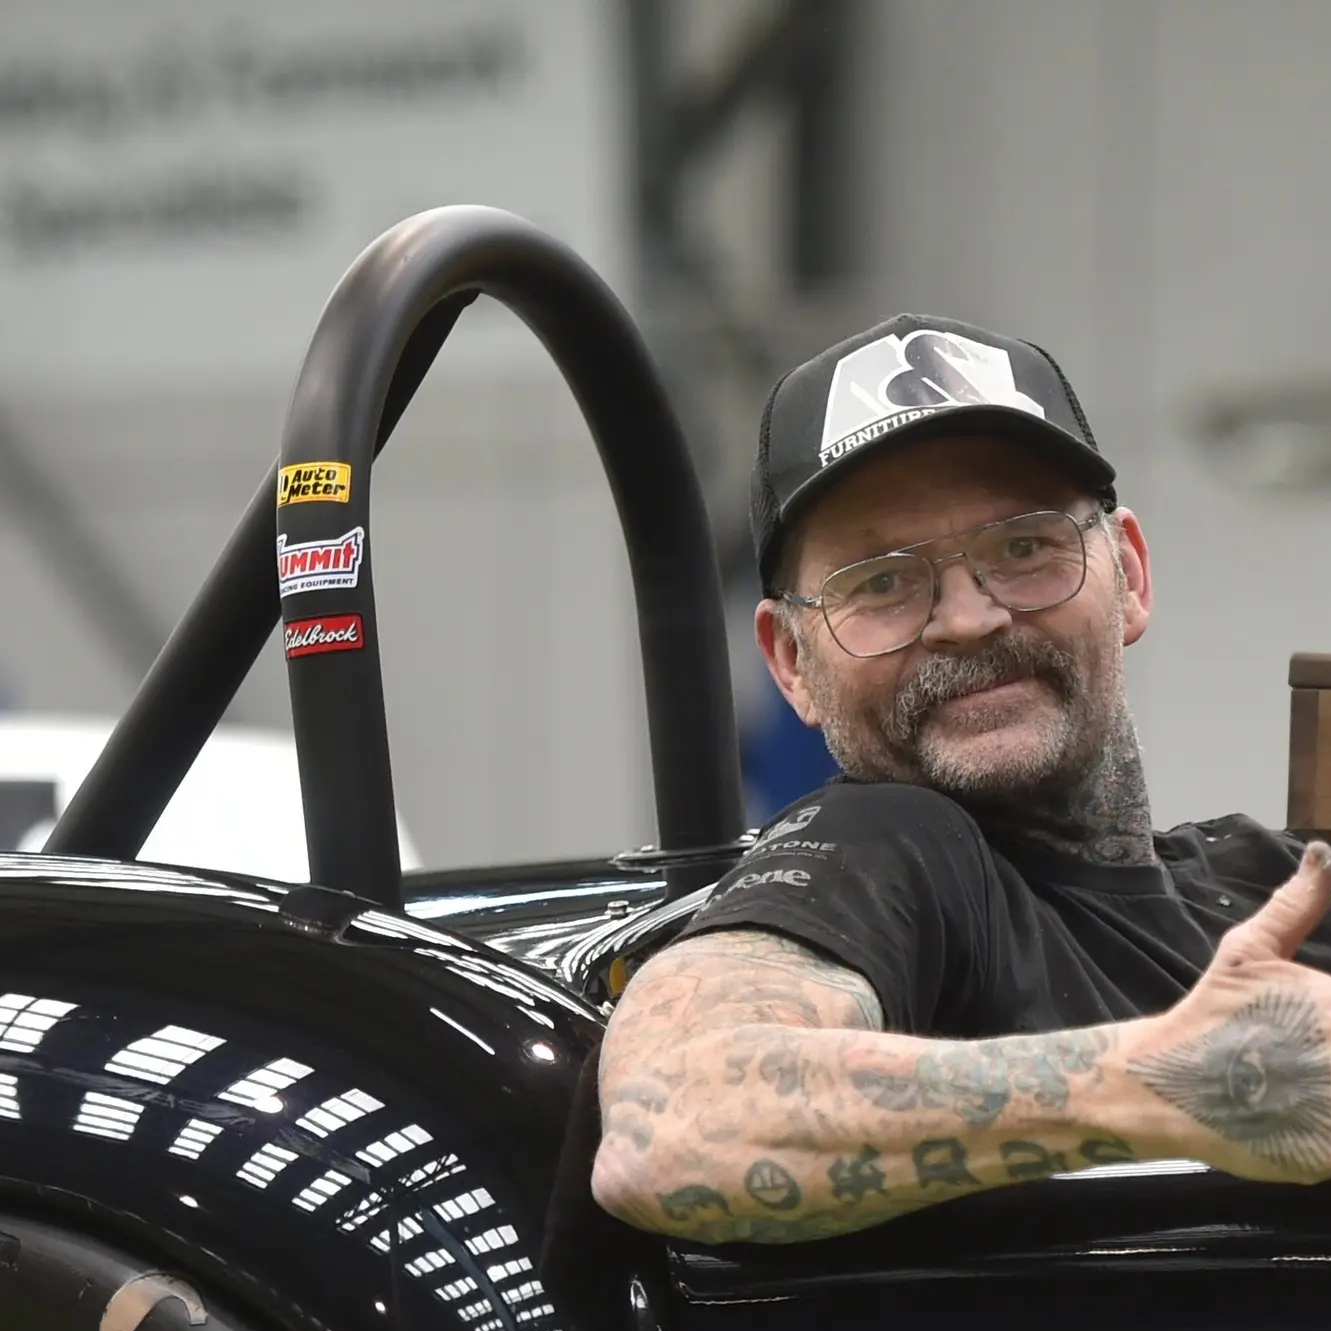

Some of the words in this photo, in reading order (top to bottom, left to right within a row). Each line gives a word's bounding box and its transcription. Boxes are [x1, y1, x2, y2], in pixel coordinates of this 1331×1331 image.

[291, 467, 337, 484] Auto
[285, 481, 346, 503] Meter
[280, 540, 355, 578] UMMIT
[301, 578, 354, 589] EQUIPMENT
[284, 622, 358, 651] Edelbrock
